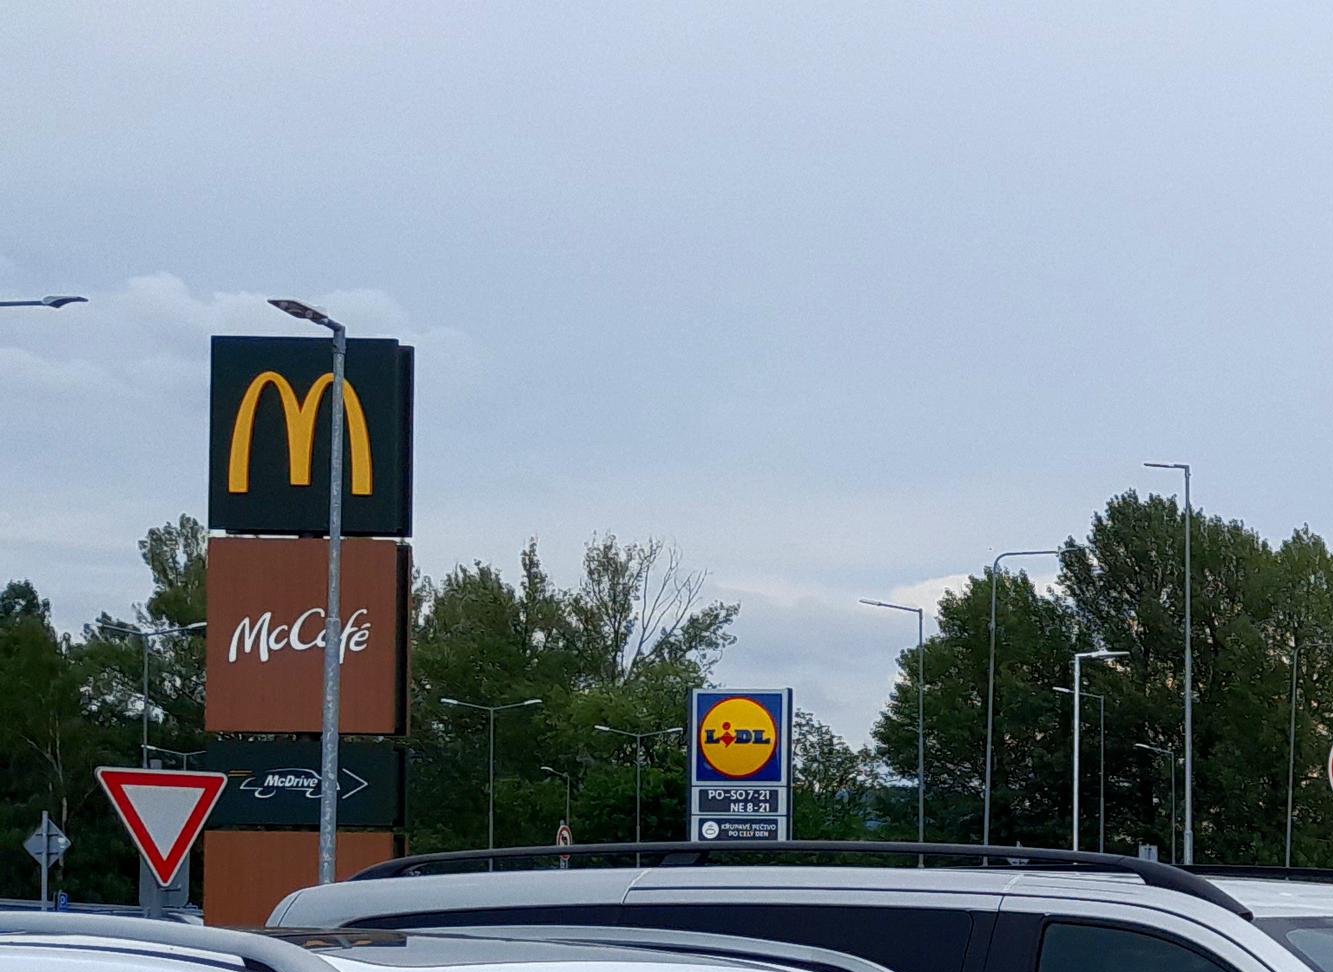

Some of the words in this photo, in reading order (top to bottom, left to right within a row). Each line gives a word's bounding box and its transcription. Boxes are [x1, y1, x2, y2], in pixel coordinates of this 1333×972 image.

[228, 607, 372, 664] McCfé
[264, 775, 318, 787] McDrive
[730, 803, 744, 812] NE
